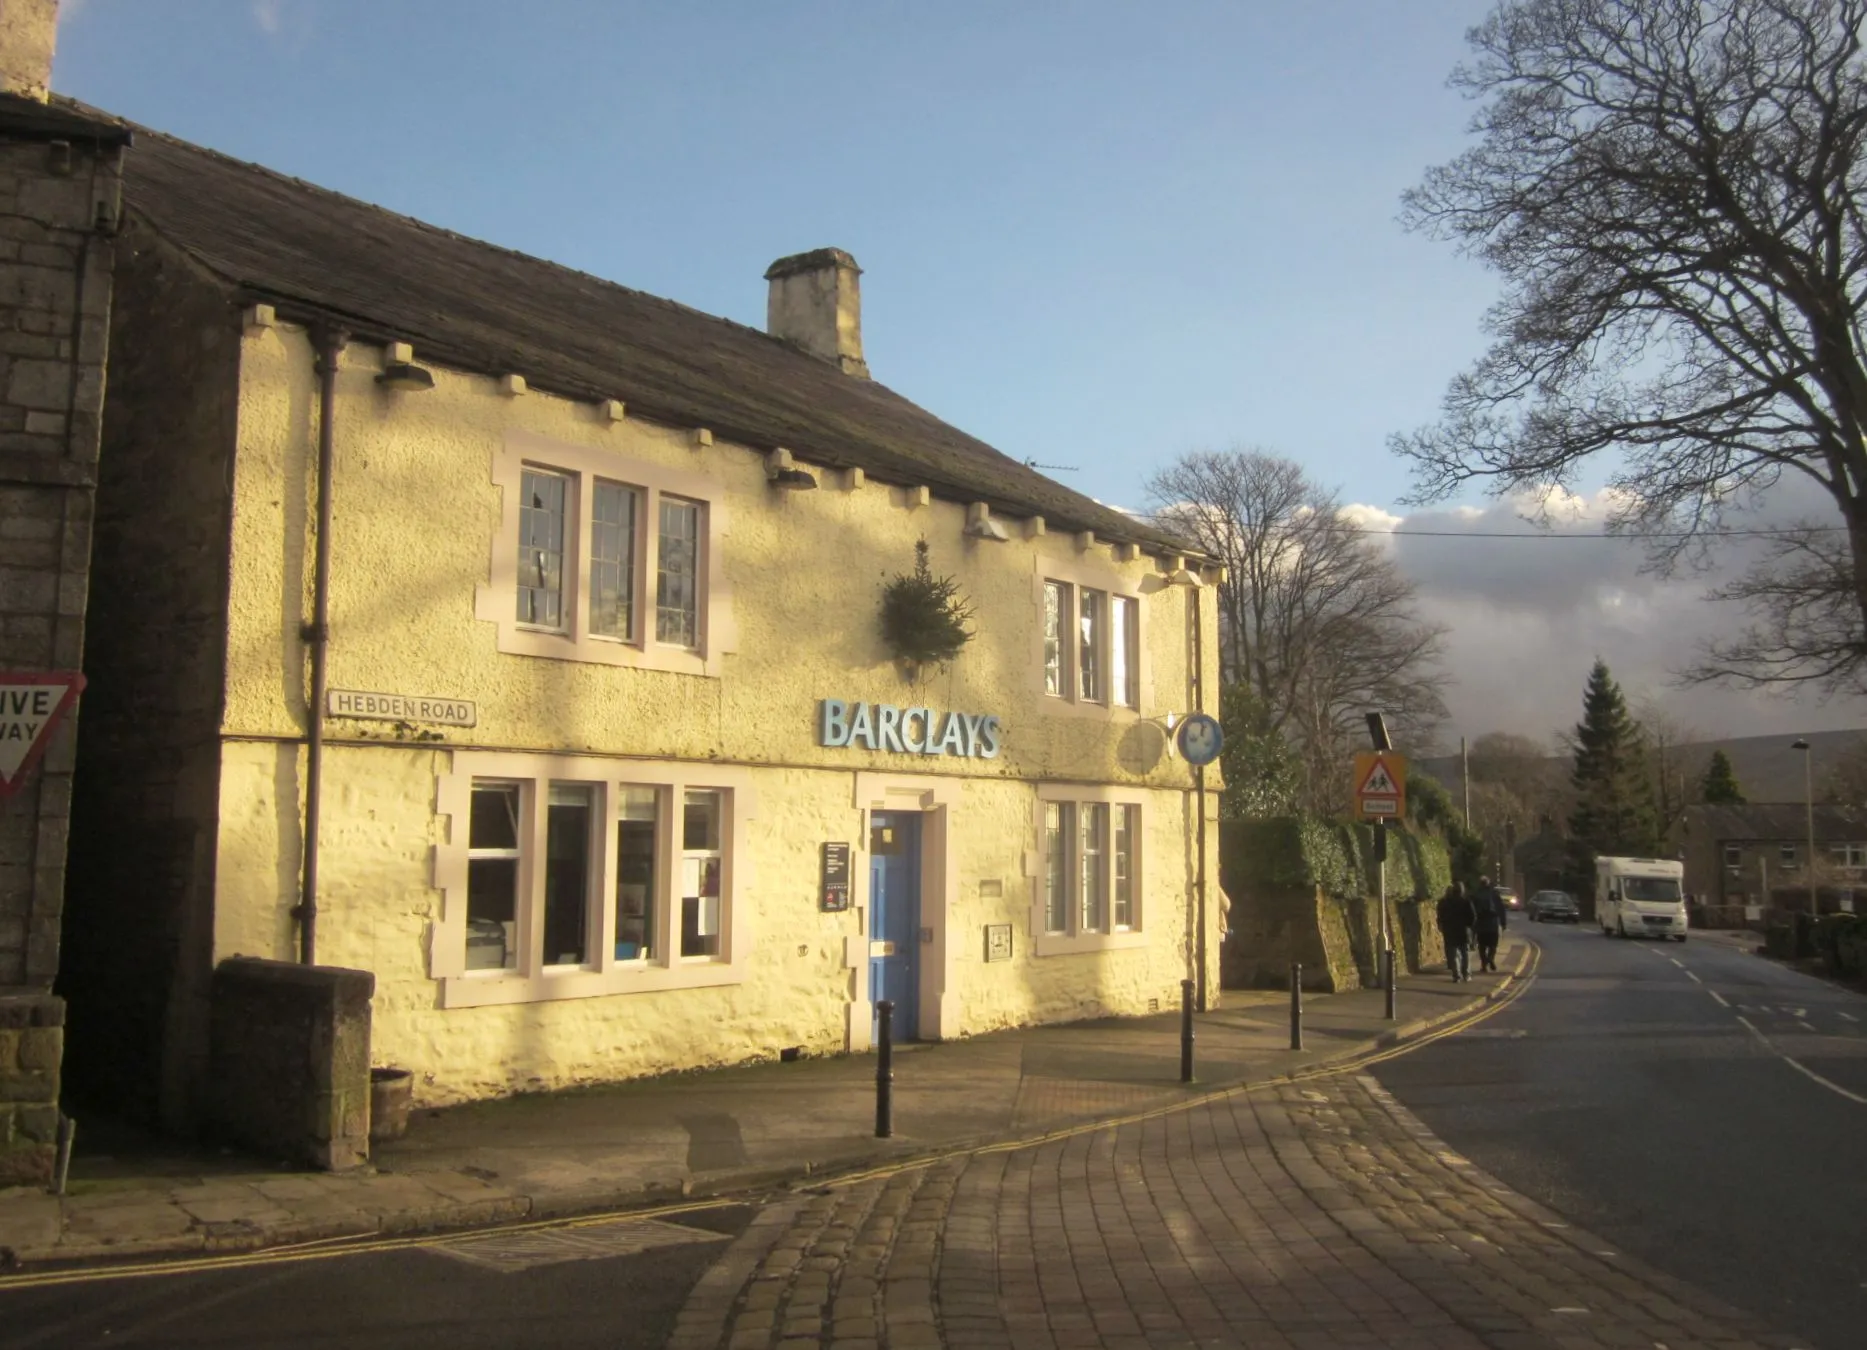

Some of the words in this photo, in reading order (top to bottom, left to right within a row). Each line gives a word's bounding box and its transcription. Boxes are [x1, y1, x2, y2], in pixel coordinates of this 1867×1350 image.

[338, 694, 416, 717] HEBDEN
[420, 702, 469, 721] ROAD
[822, 698, 1001, 759] BARCLAYS
